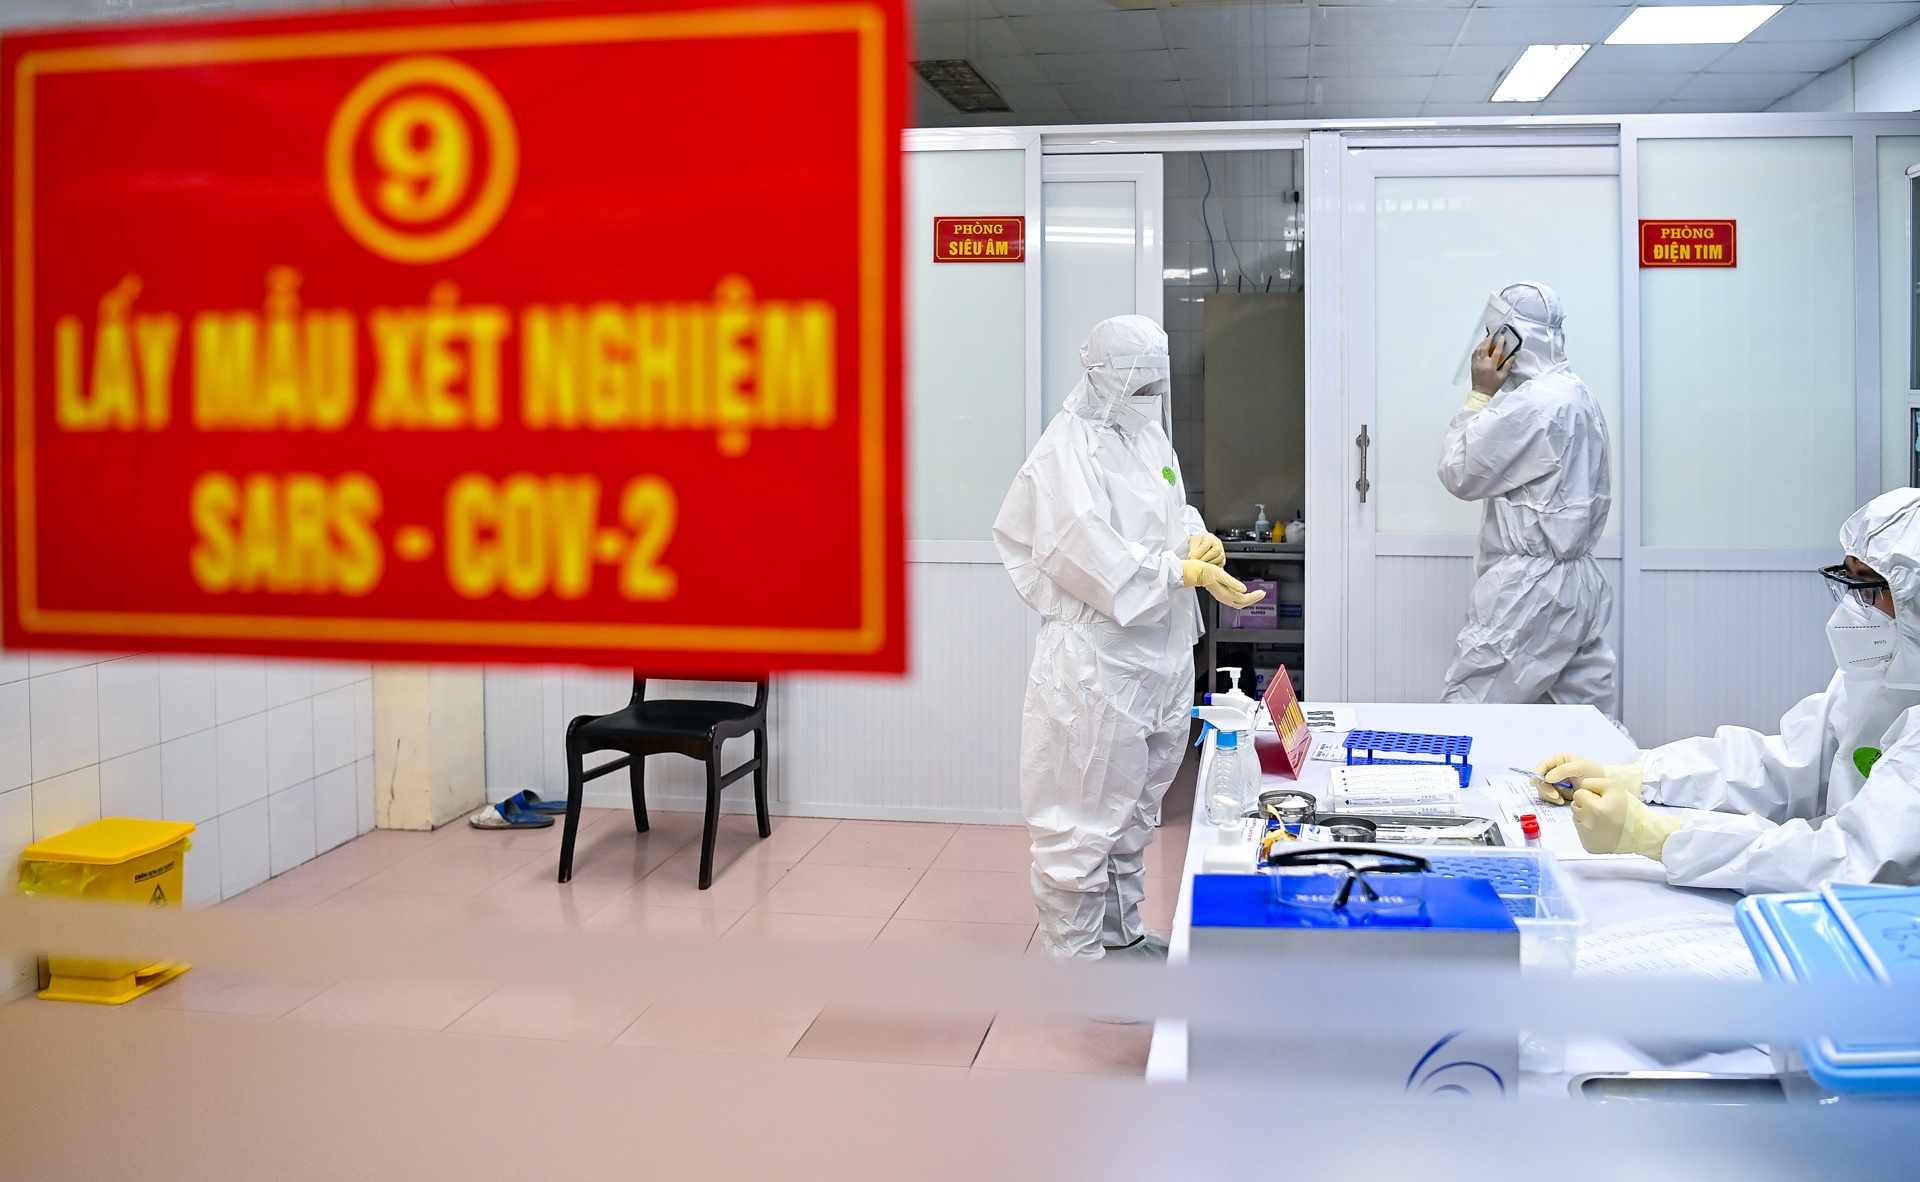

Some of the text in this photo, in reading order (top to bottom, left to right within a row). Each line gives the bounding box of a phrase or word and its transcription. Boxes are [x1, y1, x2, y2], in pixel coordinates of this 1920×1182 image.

[371, 93, 472, 224] 9
[953, 221, 1004, 235] PHÒNG
[1660, 224, 1715, 239] PHÒNG
[948, 238, 1009, 256] SIÊU ÂM
[1653, 241, 1723, 263] ĐIỆN TIM
[55, 267, 836, 456] LẤY MẪU XÉT NGHIỆM
[191, 473, 383, 595] SARS
[446, 475, 677, 599] COV-2
